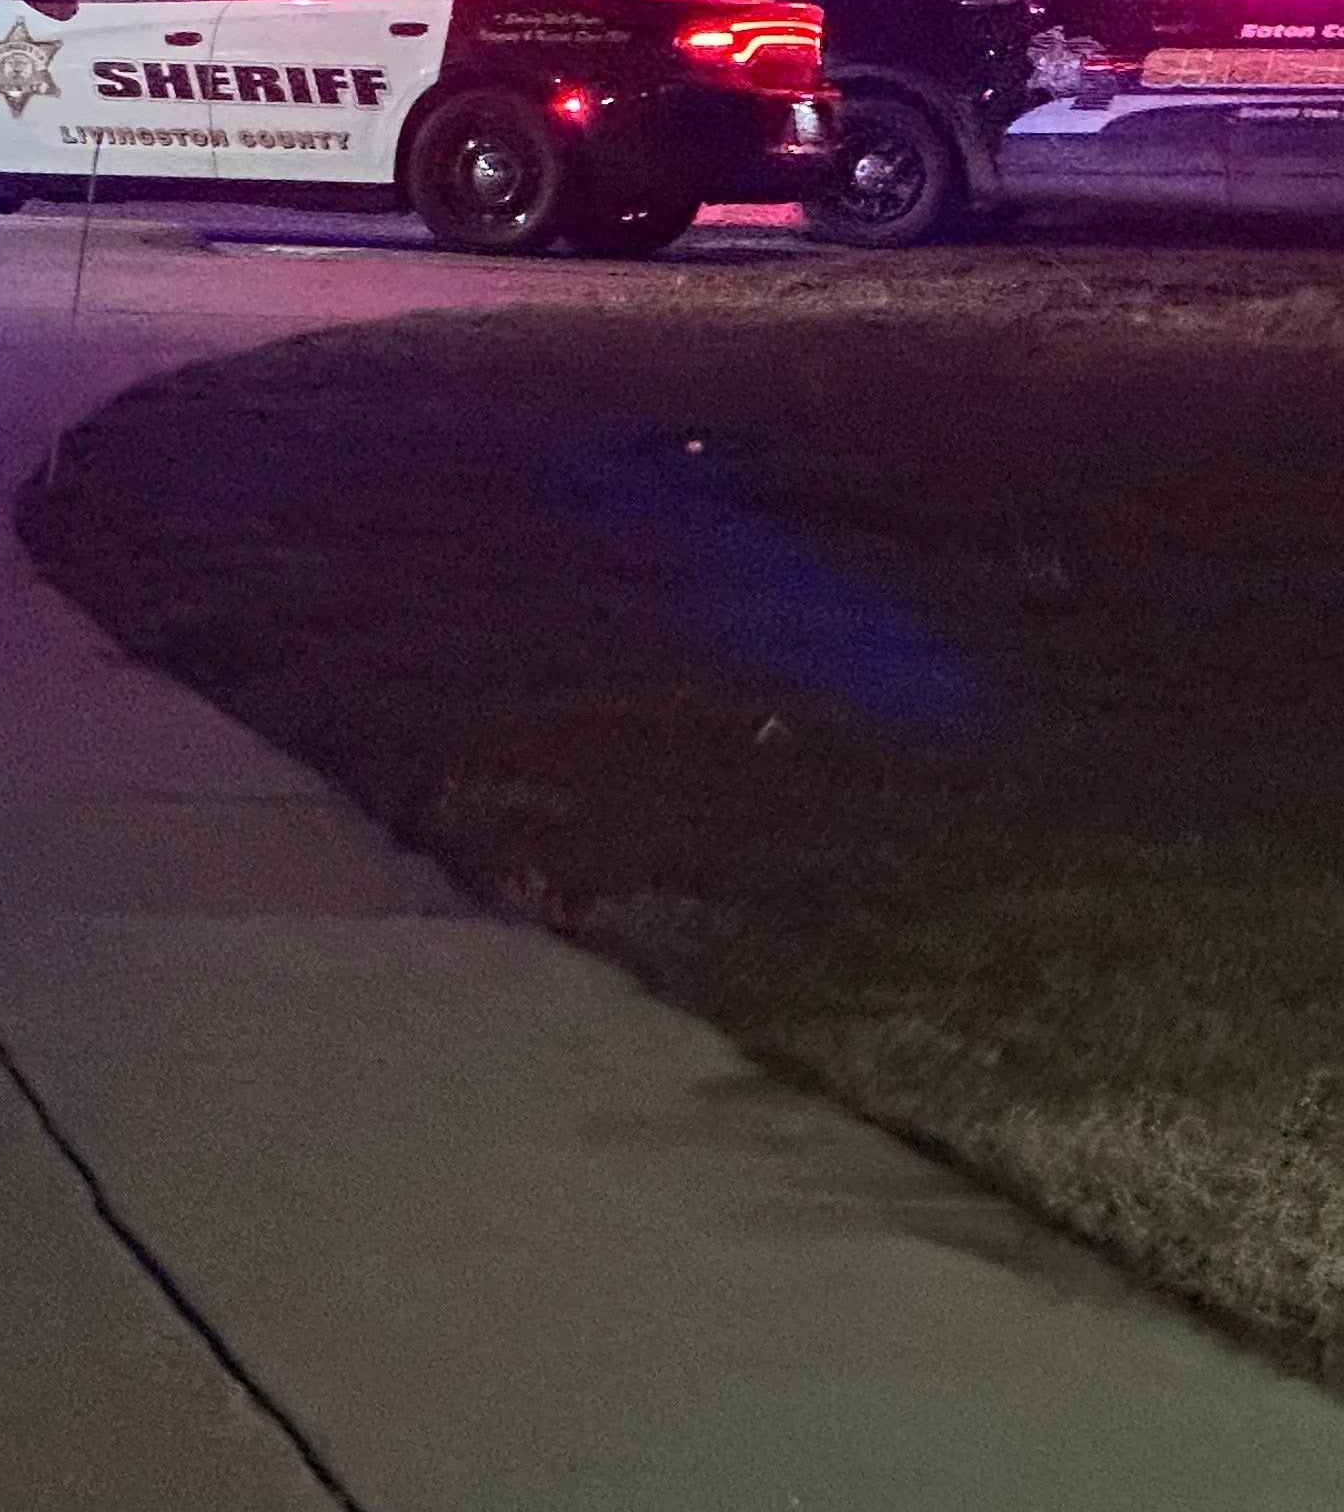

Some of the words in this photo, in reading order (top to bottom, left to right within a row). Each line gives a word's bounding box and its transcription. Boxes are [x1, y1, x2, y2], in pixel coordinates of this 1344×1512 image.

[1241, 24, 1315, 38] Eaton
[91, 59, 389, 108] SHERIFF
[59, 126, 229, 148] LIVINGSTON
[238, 129, 350, 150] COUNTY
